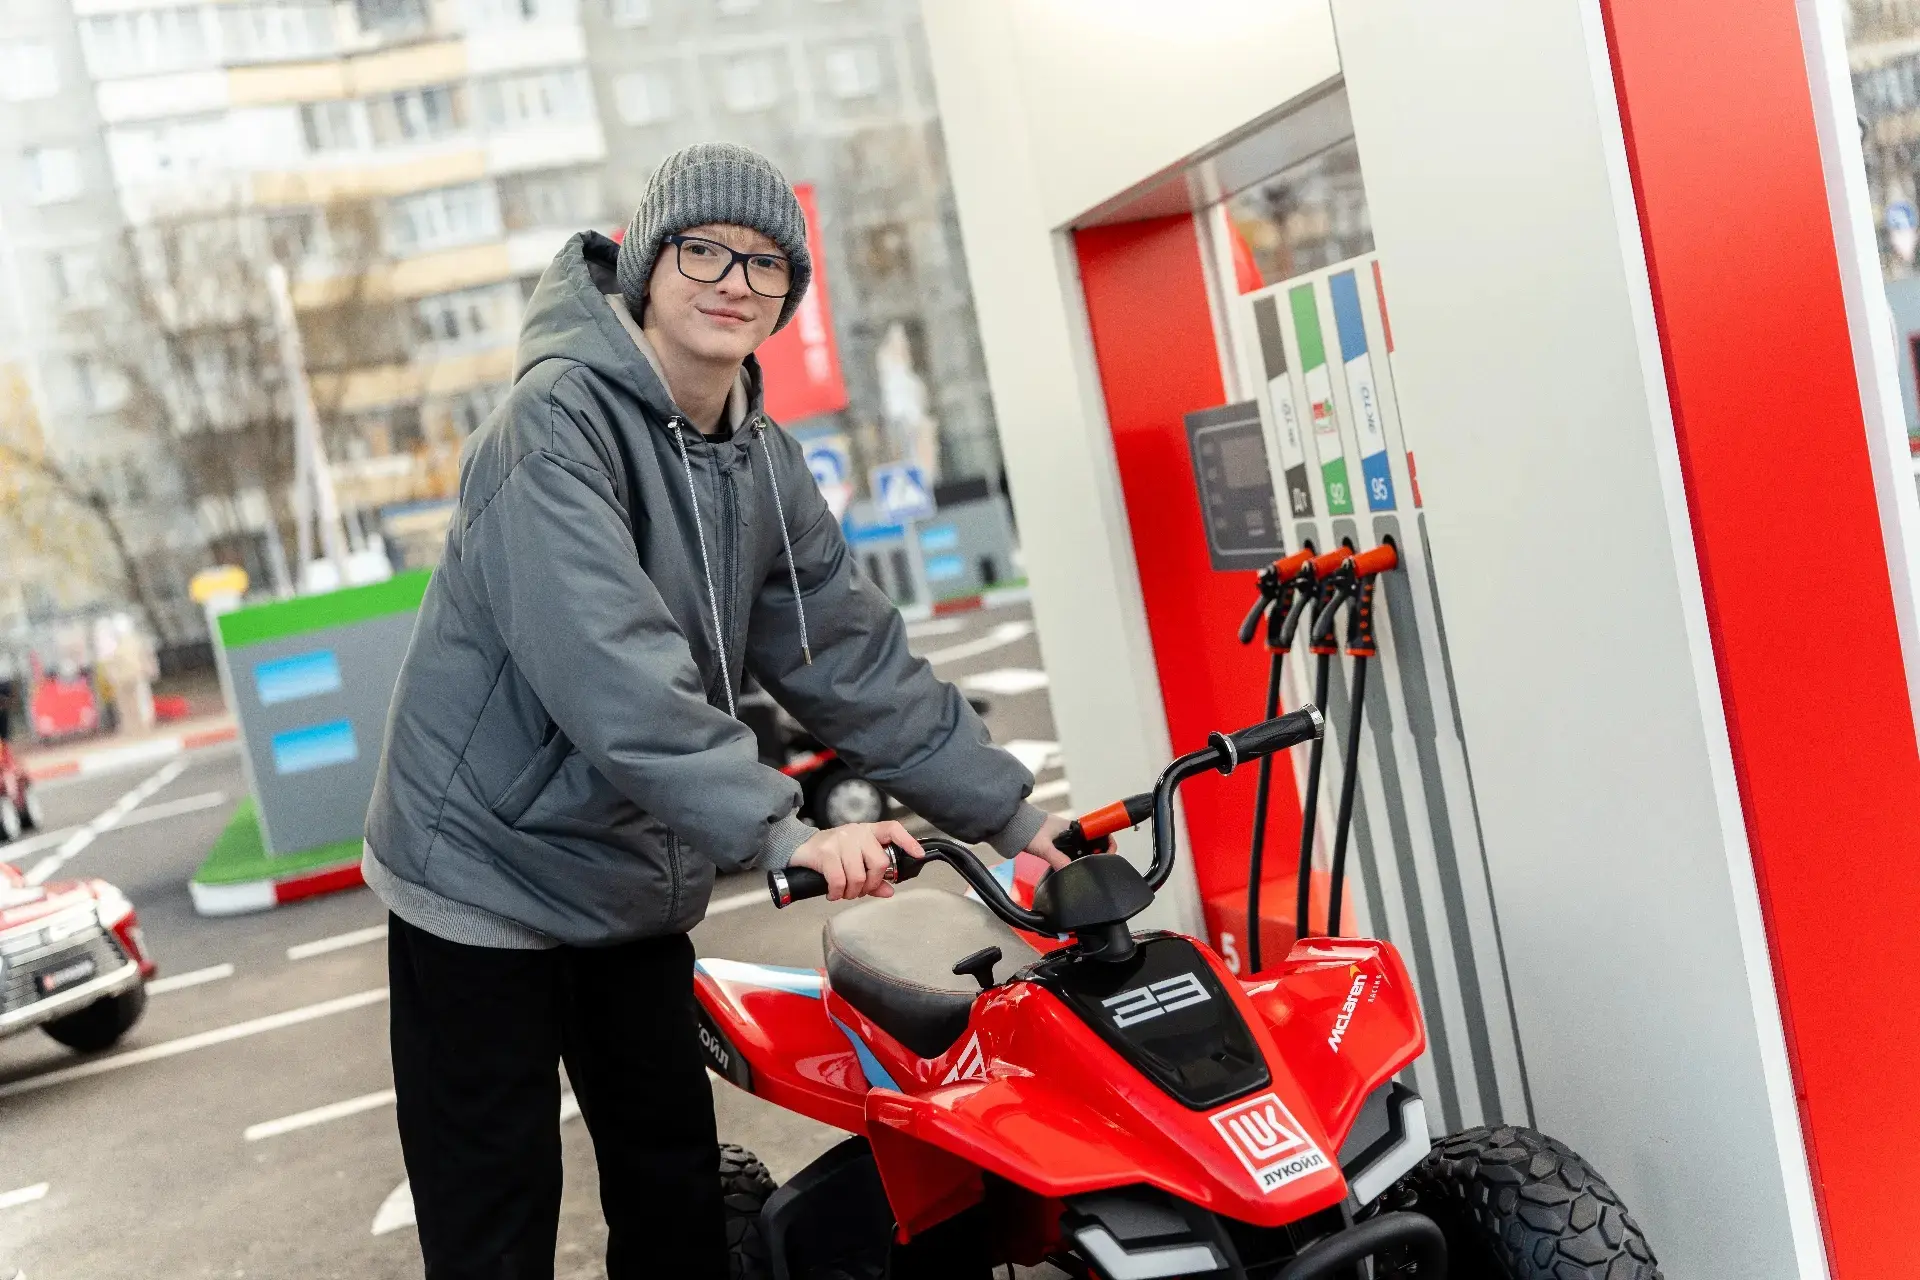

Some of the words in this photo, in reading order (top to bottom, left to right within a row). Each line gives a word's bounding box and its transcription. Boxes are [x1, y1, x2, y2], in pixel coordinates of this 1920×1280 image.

[1329, 482, 1346, 505] 92
[1371, 477, 1388, 501] 95
[1101, 971, 1212, 1029] 23
[1367, 973, 1382, 1004] RACING
[1327, 974, 1368, 1054] McLaren
[1263, 1153, 1324, 1186] ЛУКОЙЛ
